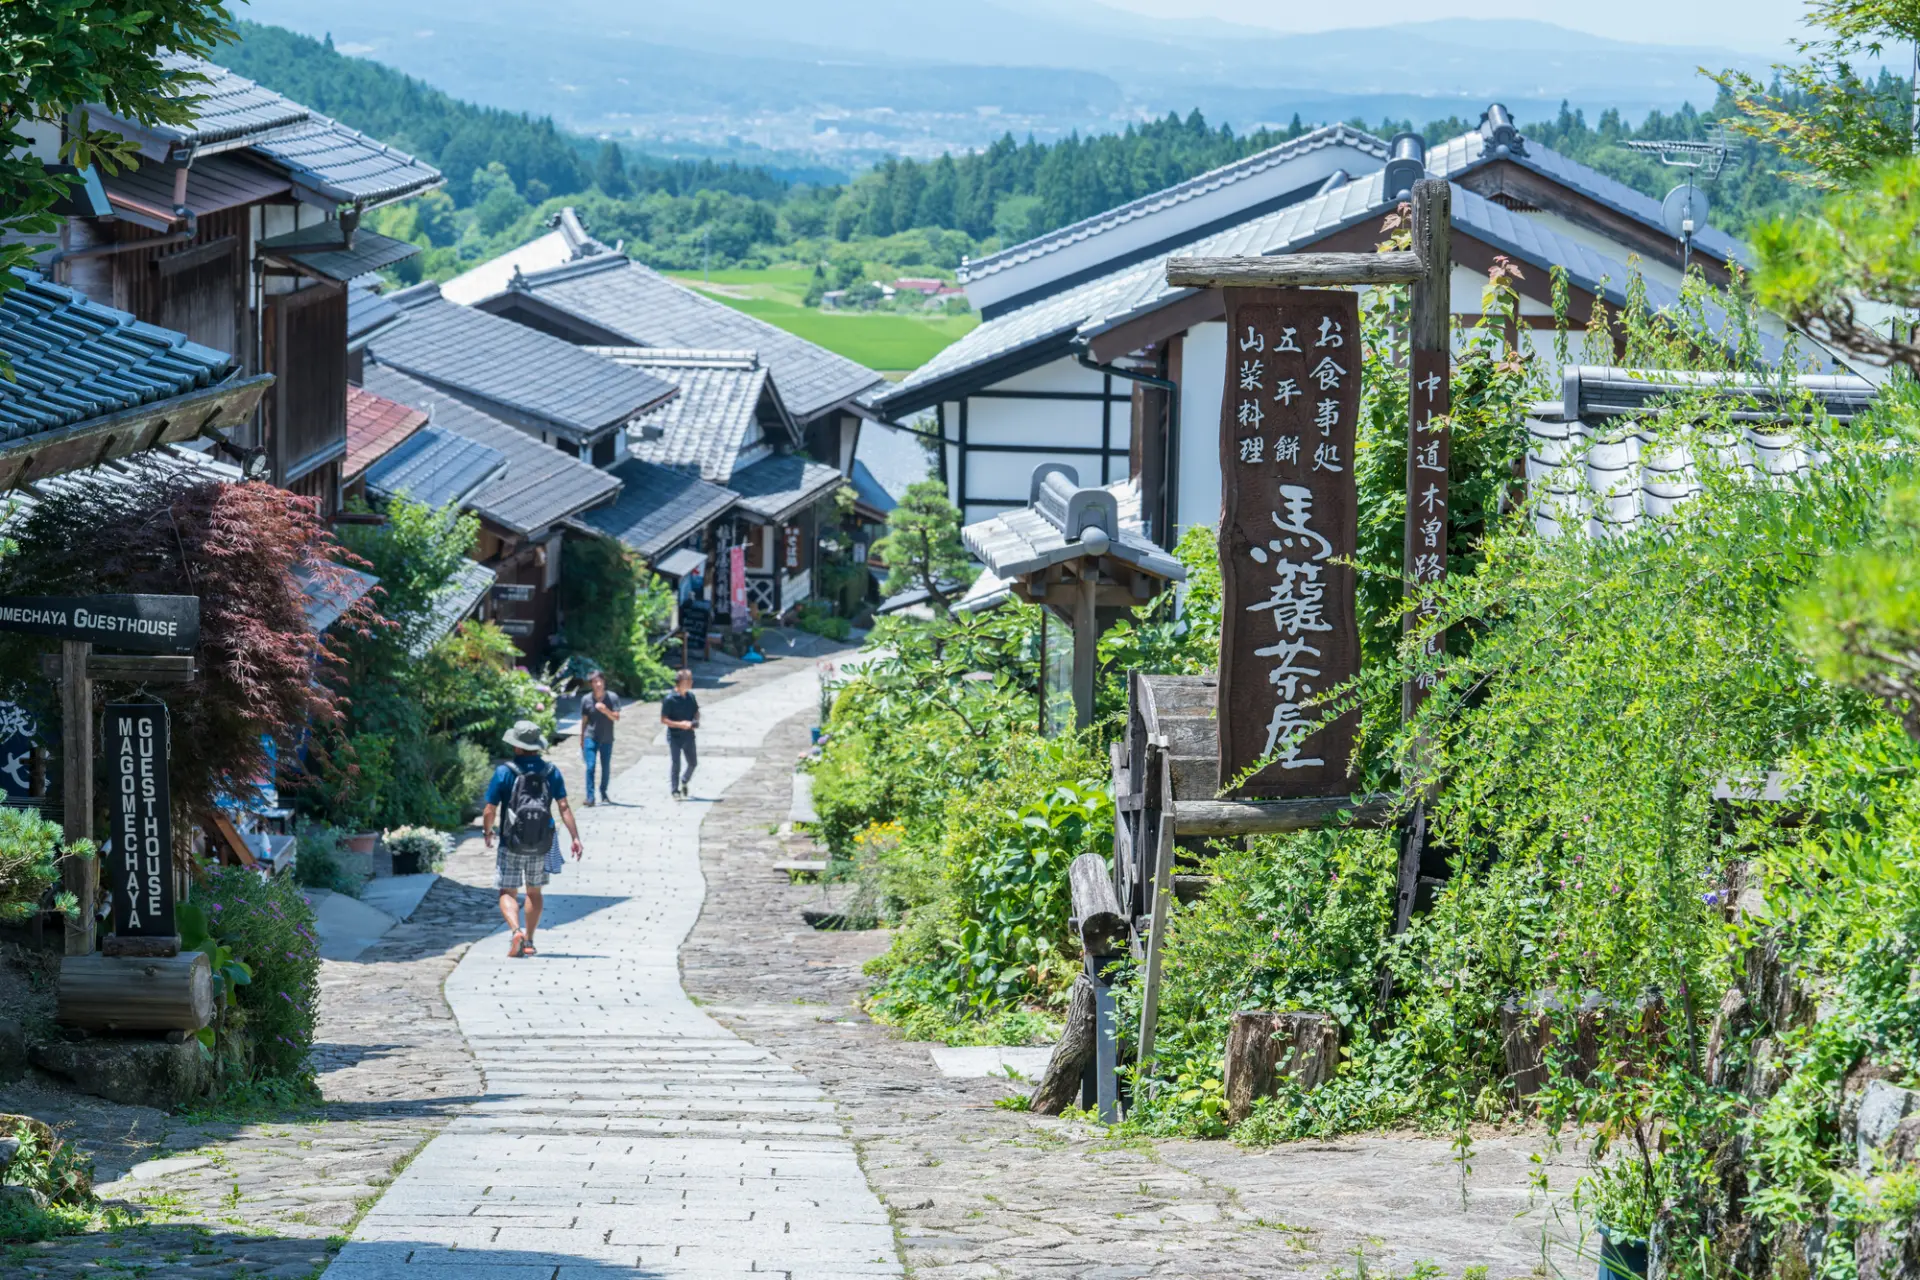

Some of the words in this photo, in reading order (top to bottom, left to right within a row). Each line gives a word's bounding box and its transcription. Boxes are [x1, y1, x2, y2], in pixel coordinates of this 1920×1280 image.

[1237, 325, 1265, 464] 山菜料理
[1272, 326, 1303, 466] 五平餅
[1309, 316, 1348, 473] お食事処
[1245, 484, 1333, 770] 馬籠茶屋
[118, 717, 142, 929] MAGOMECHAYA
[138, 717, 162, 916] GUESTHOUSE
